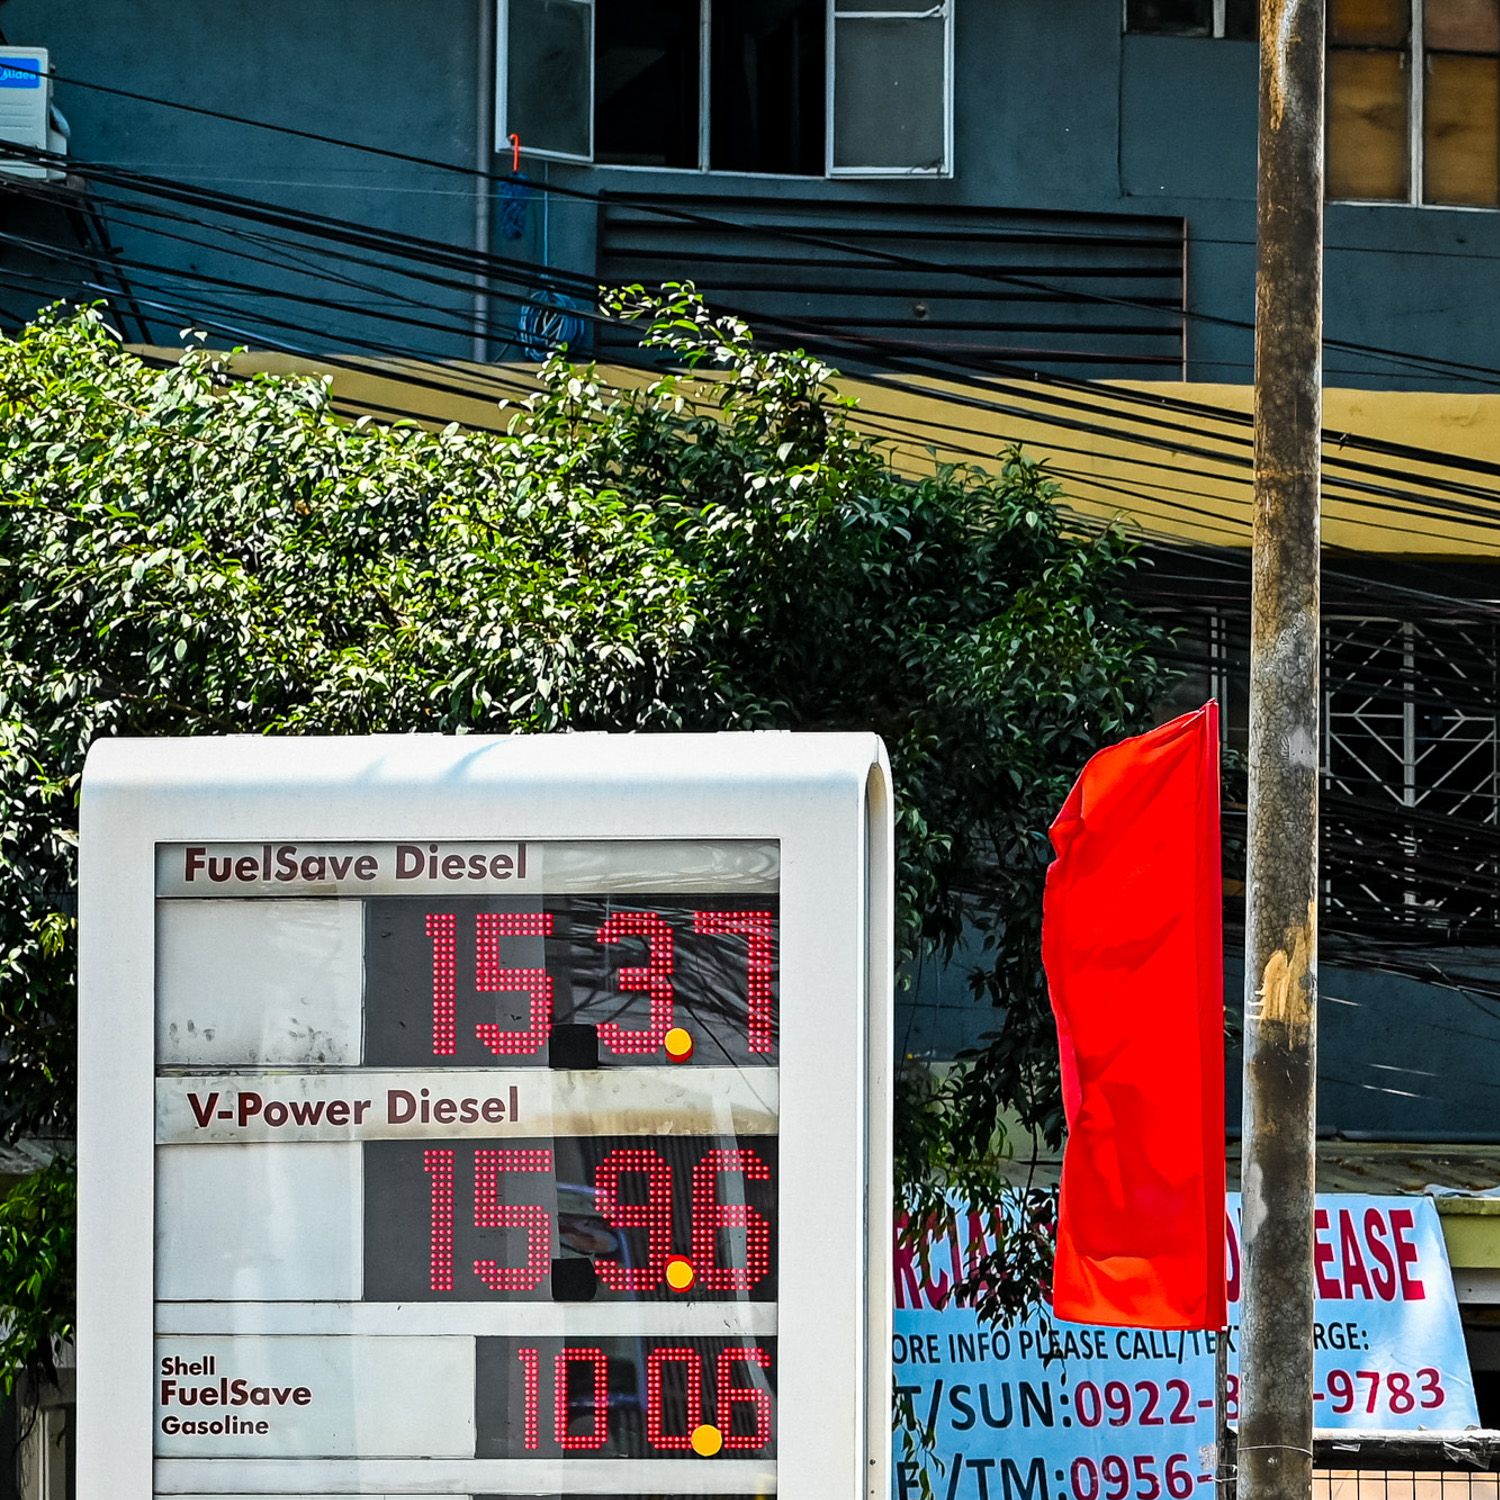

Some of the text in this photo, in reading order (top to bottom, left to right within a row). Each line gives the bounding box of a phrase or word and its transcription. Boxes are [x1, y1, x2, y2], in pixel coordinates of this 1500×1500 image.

[185, 843, 527, 882] FuelSave Diesel
[187, 1086, 518, 1128] V-Power Diesel
[1313, 1208, 1427, 1301] EASE
[892, 1333, 941, 1364] ORE
[950, 1331, 1010, 1363] INFO
[1018, 1329, 1109, 1360] PLEASE
[1313, 1322, 1370, 1351] RGE:
[161, 1356, 215, 1375] Shell
[161, 1377, 312, 1406] FuelSave
[161, 1415, 269, 1435] Gasoline
